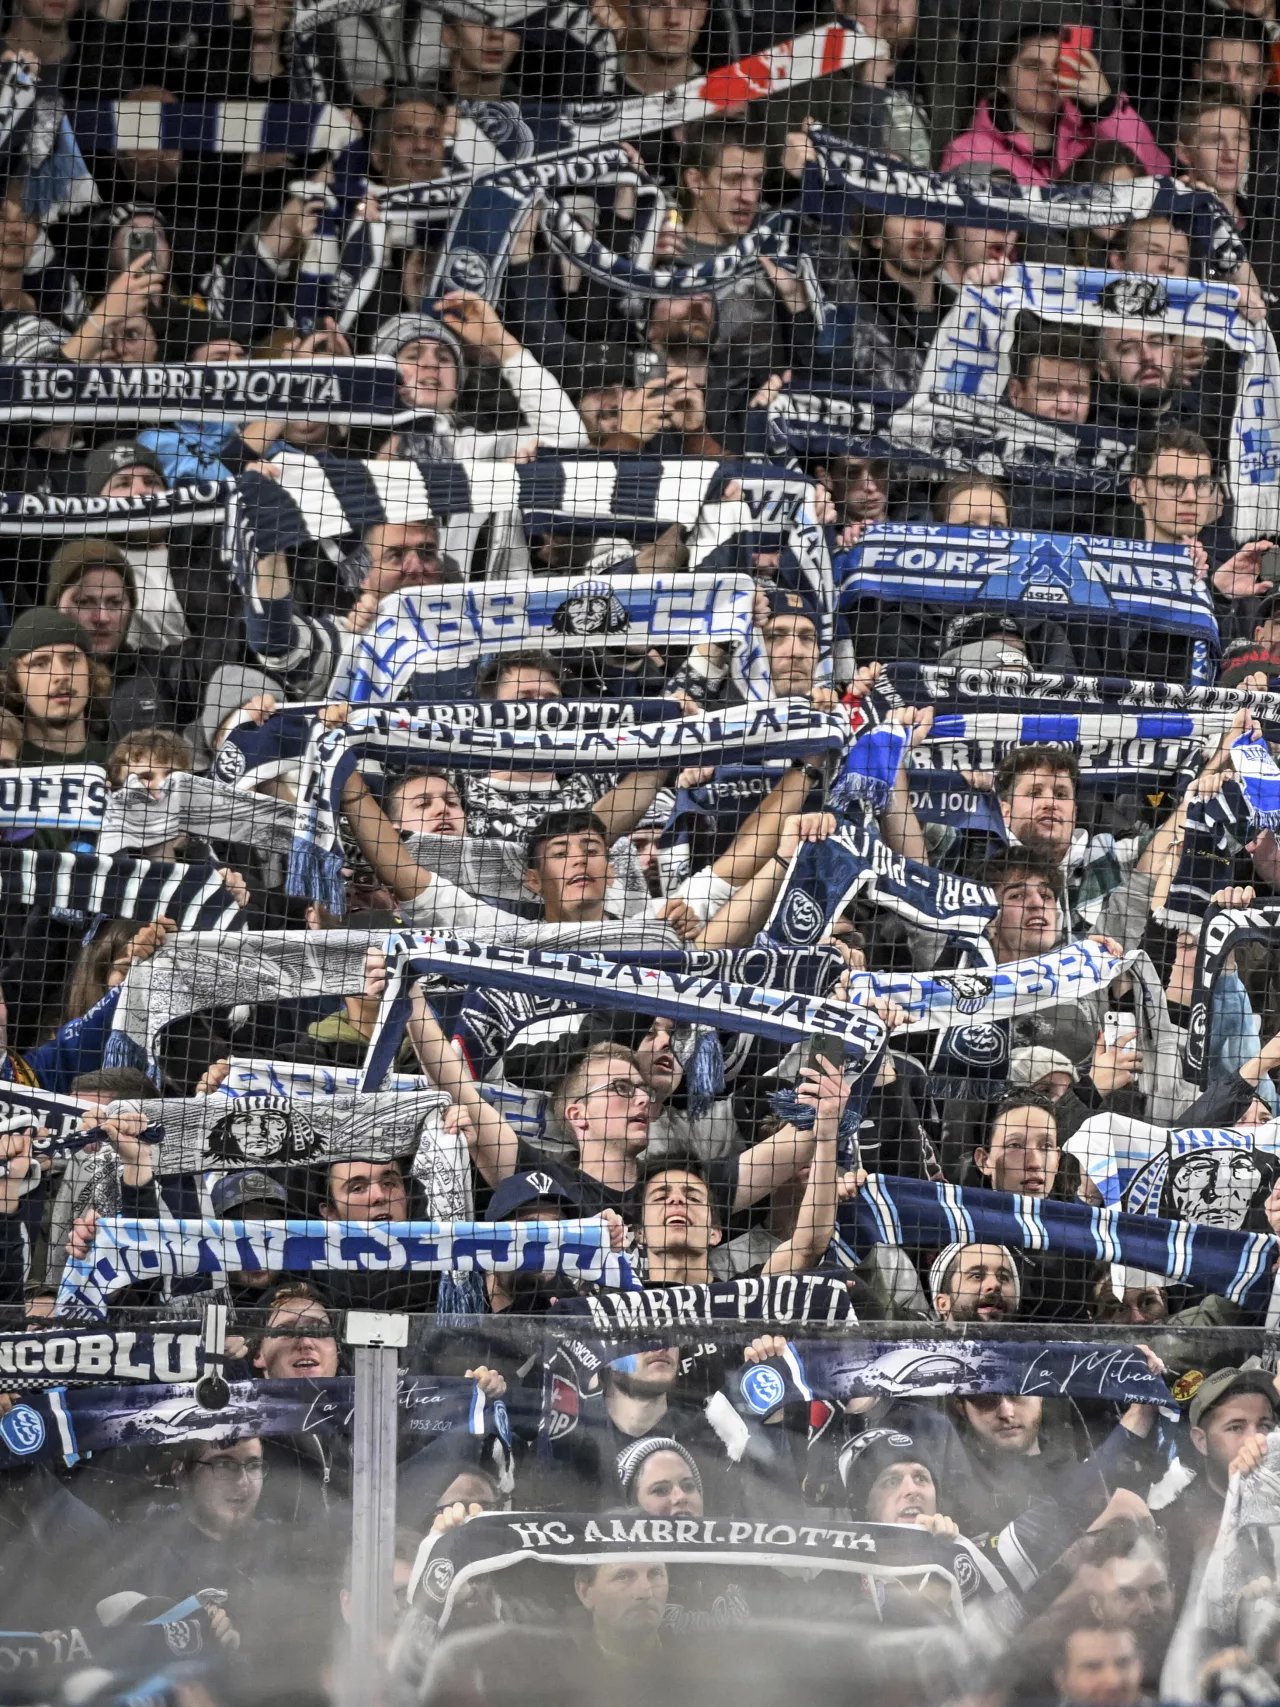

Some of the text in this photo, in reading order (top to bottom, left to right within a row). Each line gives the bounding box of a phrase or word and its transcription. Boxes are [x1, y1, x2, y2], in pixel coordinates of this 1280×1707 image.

[21, 363, 343, 403] HC AMBRI-PIOTTA
[970, 529, 1038, 542] CLUB
[1072, 535, 1153, 552] AMBRI
[1029, 591, 1065, 602] 1937
[919, 664, 1105, 705] FORZA
[405, 702, 635, 732] MBRI-PIOTTA
[912, 740, 996, 770] BRI
[507, 1518, 878, 1553] HC AMBRI-PIOTTA
